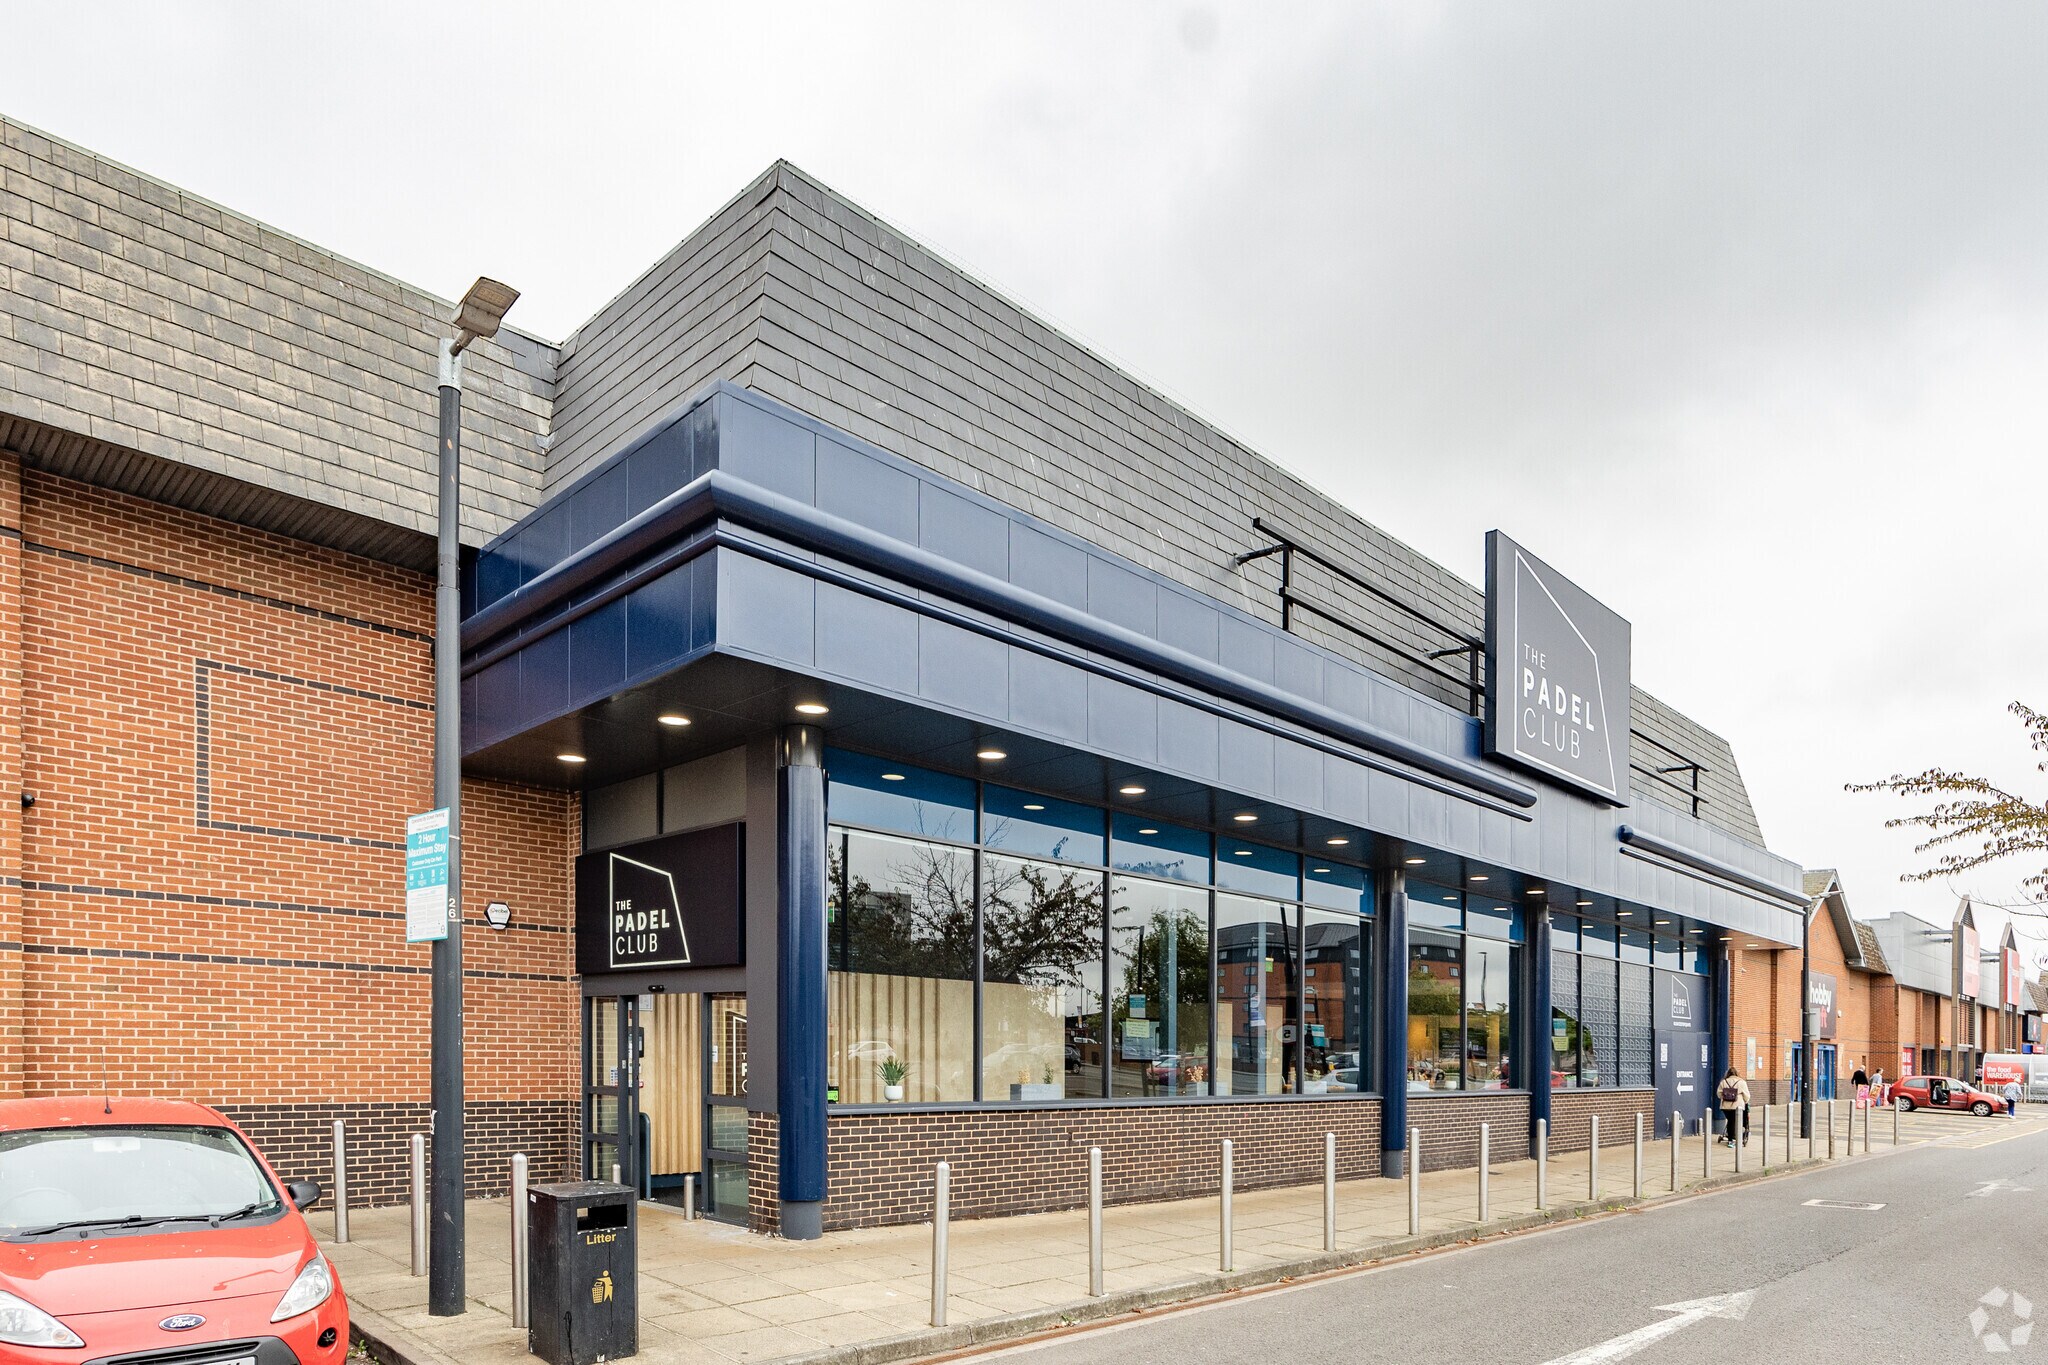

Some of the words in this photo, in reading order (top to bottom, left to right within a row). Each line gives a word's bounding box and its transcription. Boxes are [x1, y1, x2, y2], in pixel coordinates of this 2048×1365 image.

[1524, 643, 1546, 670] THE
[1523, 667, 1595, 732] PADEL
[1523, 707, 1581, 759] CLUB
[615, 899, 632, 912] THE
[615, 908, 670, 934] PADEL
[615, 933, 658, 955] CLUB
[1809, 980, 1832, 1013] hobby
[586, 1232, 617, 1245] Litter
[170, 1316, 196, 1328] Ford
